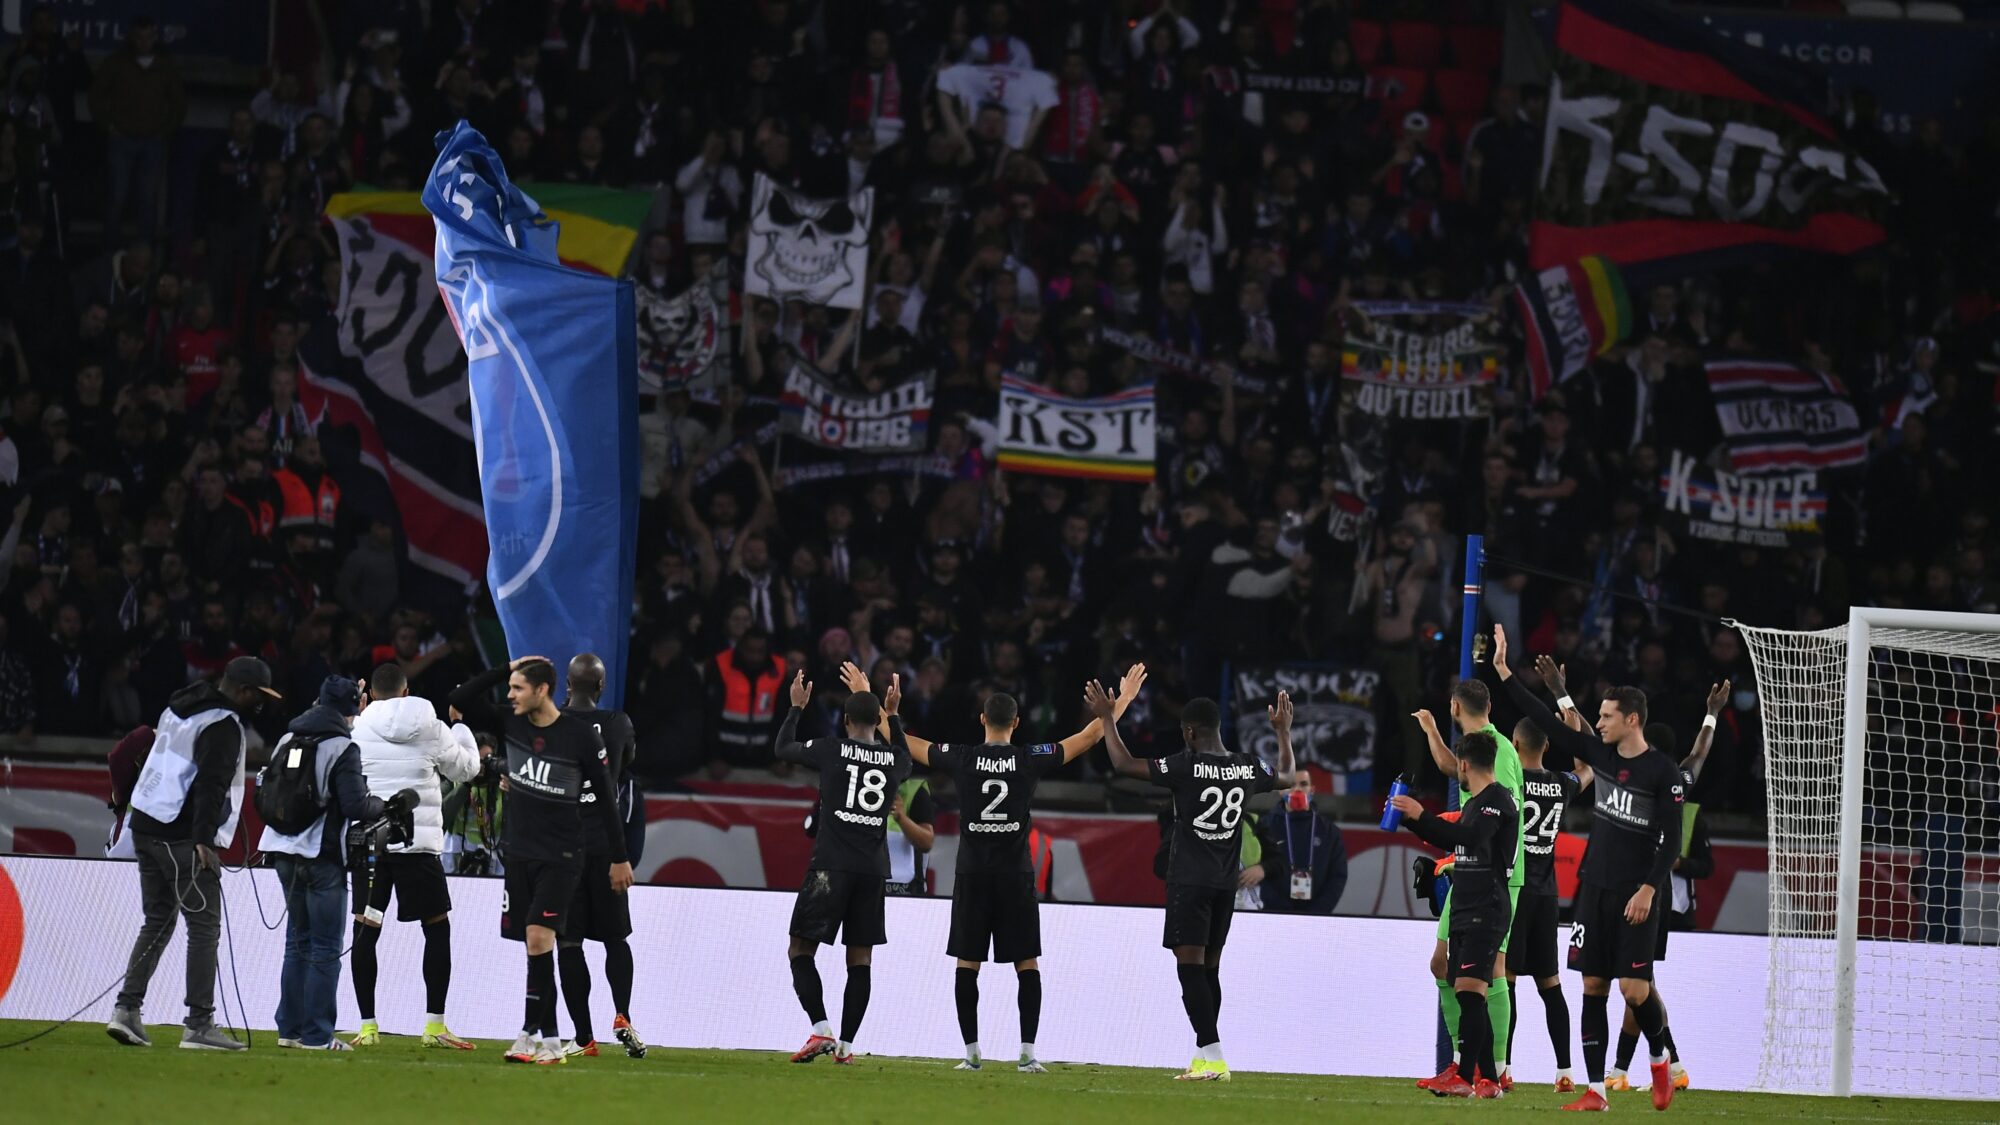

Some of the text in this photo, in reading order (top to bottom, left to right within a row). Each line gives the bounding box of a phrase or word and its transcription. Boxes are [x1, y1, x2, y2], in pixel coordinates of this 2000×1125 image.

[1779, 43, 1874, 64] ACCOR
[1386, 352, 1456, 384] 1991
[784, 364, 934, 418] AUTEUIL
[1356, 383, 1479, 419] AUTEUIL
[1005, 396, 1152, 454] KST
[1736, 400, 1839, 435] ULTRAS
[840, 743, 895, 766] WIJNALDUM
[976, 754, 1017, 773] HAKIMI
[142, 772, 163, 798] PROD
[845, 763, 887, 811] 18
[1193, 762, 1256, 781] DINA EBIMBE
[980, 778, 1009, 821] 2
[1525, 781, 1562, 797] KEHRER
[1192, 786, 1245, 831] 28
[1523, 800, 1564, 843] 24
[968, 821, 1020, 832] ooredoo
[1570, 921, 1586, 948] 23
